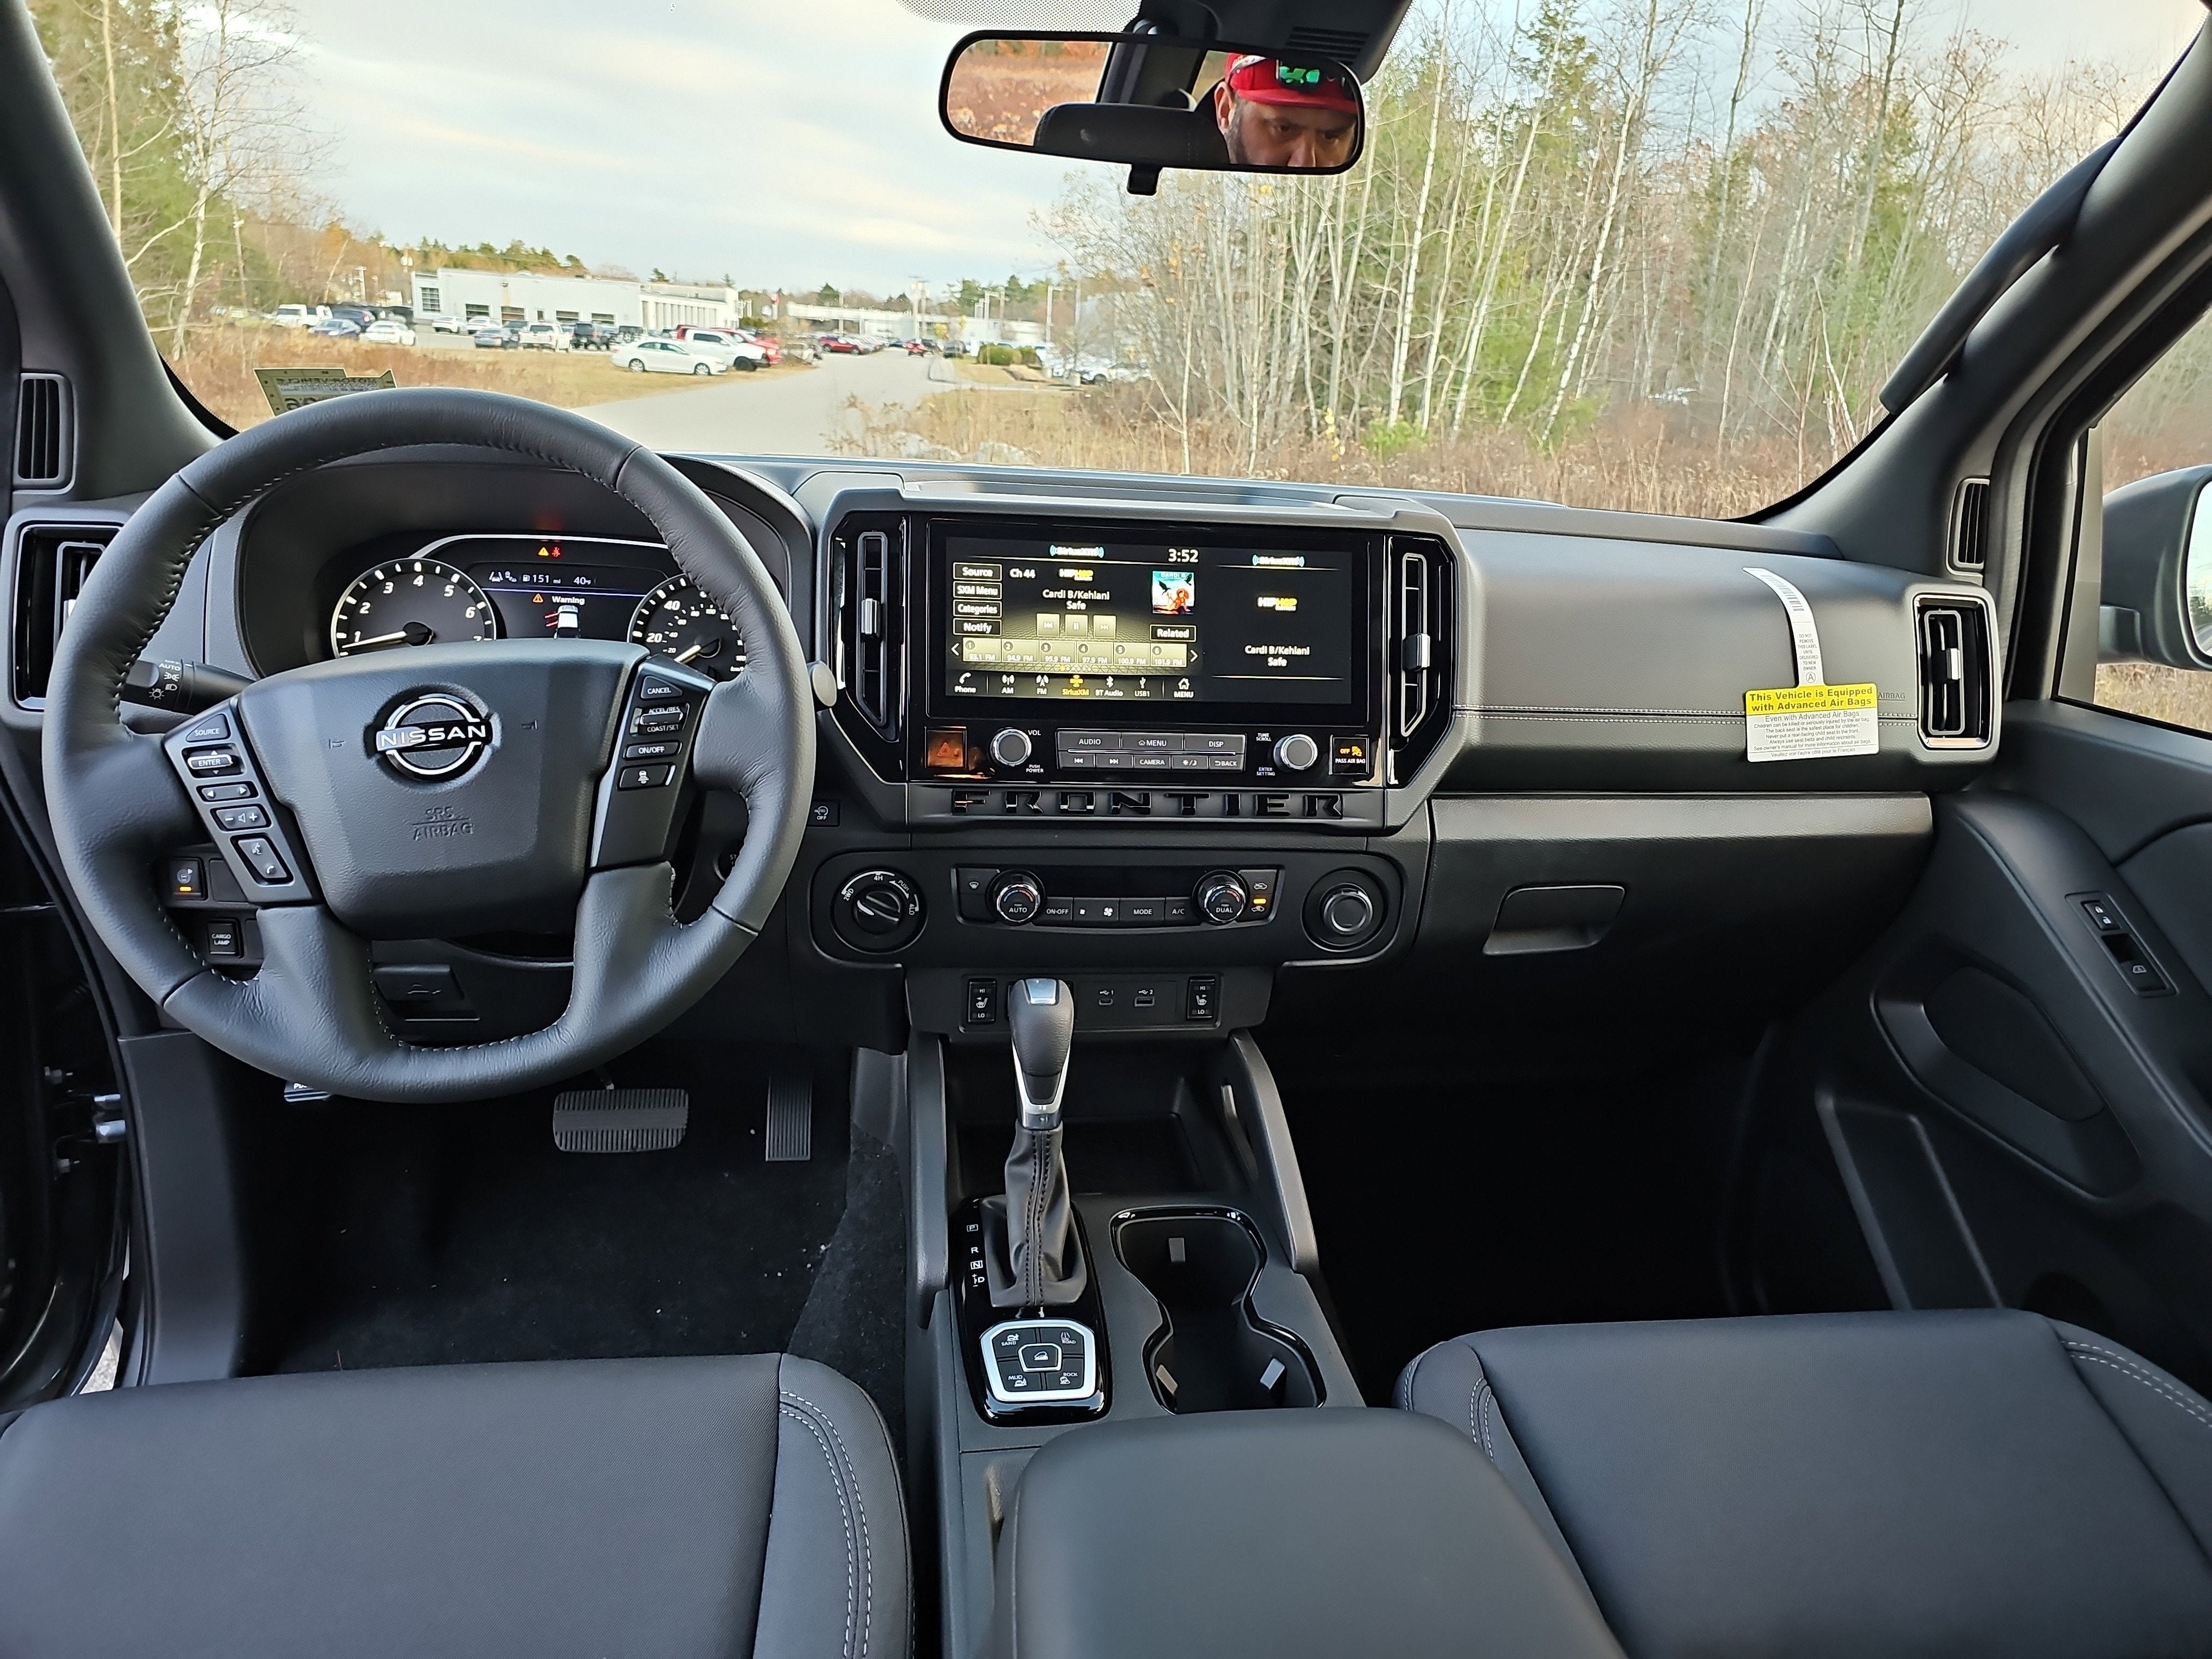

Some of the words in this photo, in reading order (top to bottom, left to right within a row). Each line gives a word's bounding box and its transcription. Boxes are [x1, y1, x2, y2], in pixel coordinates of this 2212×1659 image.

[1168, 549, 1199, 563] 3:52
[962, 567, 993, 577] Source
[1009, 569, 1023, 578] Ch
[1024, 569, 1036, 578] 44
[413, 575, 423, 587] 4
[532, 575, 549, 583] 151
[383, 582, 394, 594] 3
[443, 584, 454, 597] 5
[957, 586, 975, 595] SXM
[976, 586, 998, 595] Menu
[1042, 589, 1066, 599] Cardi
[1068, 590, 1110, 600] B/Kehlani
[551, 596, 585, 606] Warning
[664, 600, 680, 610] 40
[1066, 601, 1086, 610] Safe
[359, 602, 371, 614] 2
[465, 606, 476, 618] 6
[957, 604, 998, 615] Categories
[963, 623, 992, 634] Notify
[1157, 628, 1189, 638] Related
[355, 631, 361, 642] 1
[646, 633, 663, 642] 20
[1245, 645, 1268, 654] Cardi
[1269, 646, 1310, 655] B/Kehlani
[159, 663, 181, 671] AUTO
[1268, 657, 1287, 666] Safe
[1062, 688, 1089, 696] SiriusXM
[1750, 693, 1771, 702] This
[1776, 691, 1812, 700] Vehicle
[1827, 687, 1873, 698] Equipped
[1752, 703, 1774, 711] with
[1777, 699, 1827, 710] Advanced
[1830, 699, 1844, 707] Air
[1847, 698, 1872, 706] Bags
[1798, 712, 1831, 720] Advanced
[195, 728, 220, 736] SOURCE
[647, 724, 679, 732] COAST/SET
[381, 725, 486, 747] NISSAN
[198, 758, 221, 767] ENTER
[951, 790, 1343, 819] FRONTIER
[425, 806, 455, 821] SRS
[413, 822, 473, 840] AIRBAG
[897, 879, 910, 891] PUSH
[843, 888, 854, 902] 2WD
